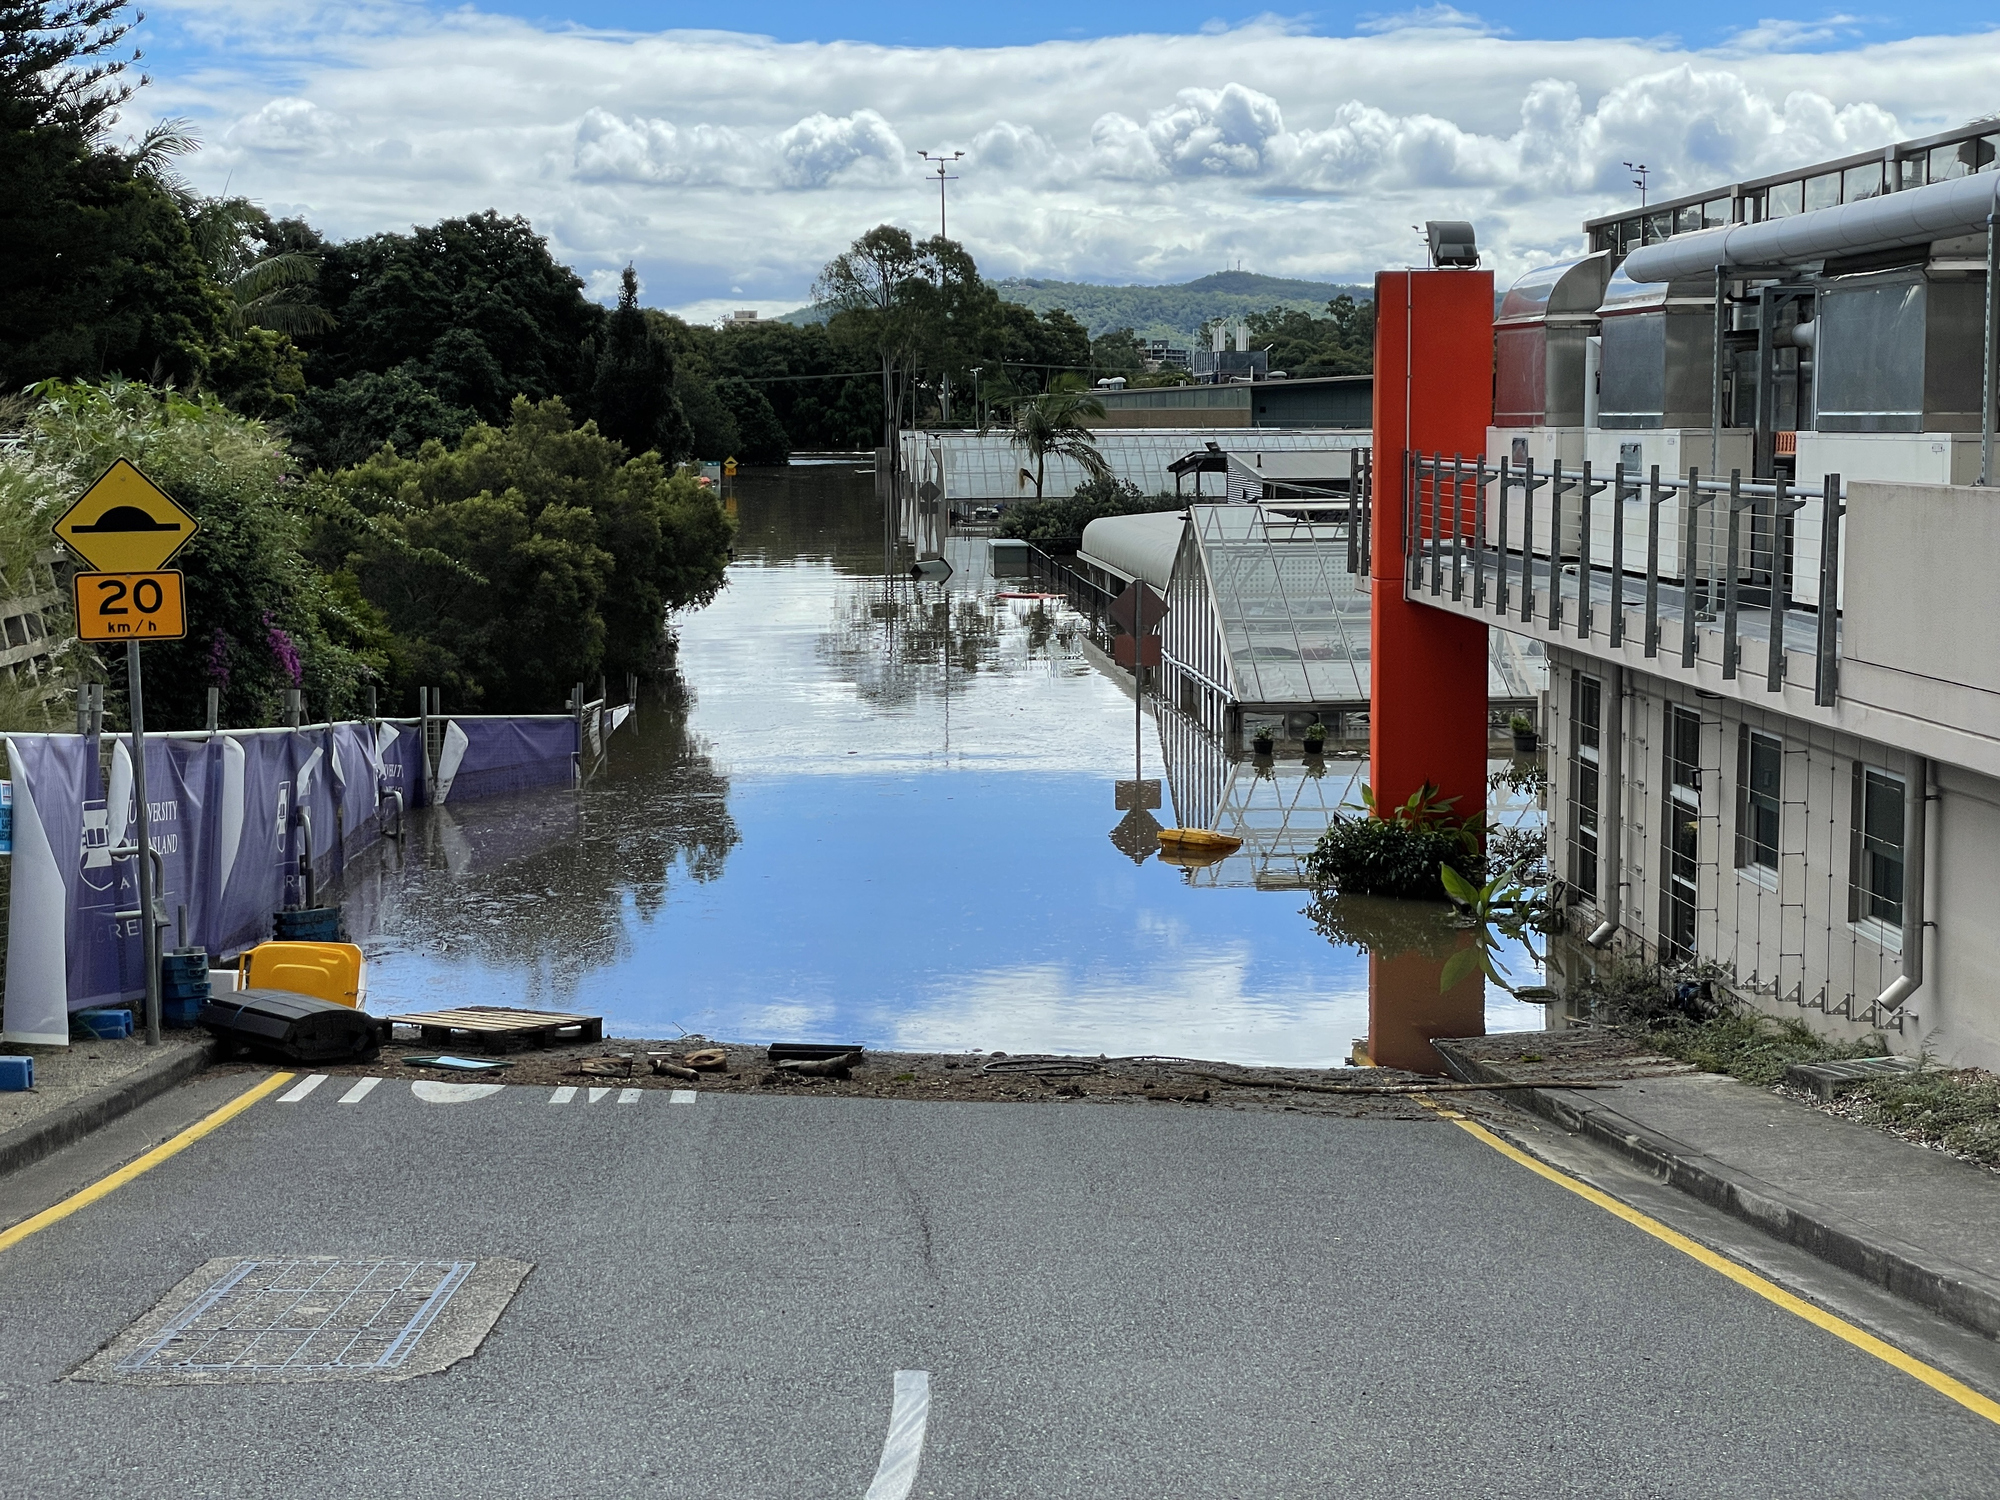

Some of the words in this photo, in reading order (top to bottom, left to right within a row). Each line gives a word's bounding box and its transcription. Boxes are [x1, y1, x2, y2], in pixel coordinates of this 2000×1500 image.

[97, 578, 163, 615] 20
[107, 619, 157, 633] km/h
[128, 800, 178, 824] UVERSITY
